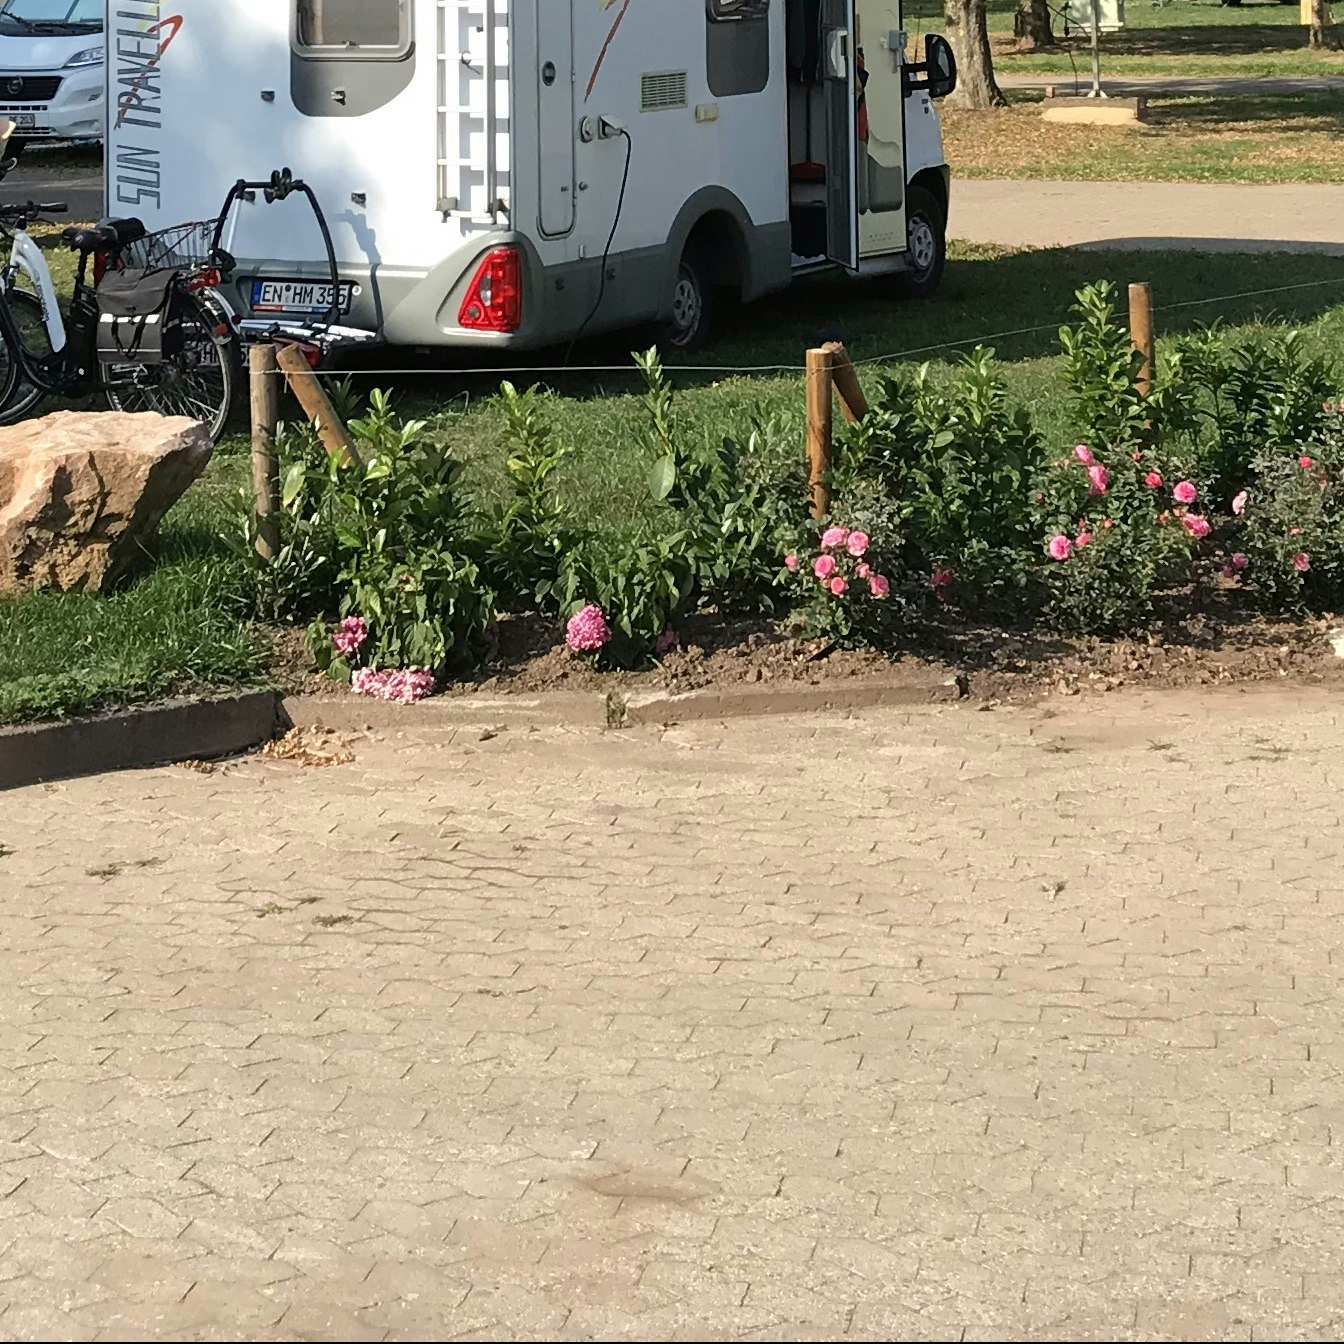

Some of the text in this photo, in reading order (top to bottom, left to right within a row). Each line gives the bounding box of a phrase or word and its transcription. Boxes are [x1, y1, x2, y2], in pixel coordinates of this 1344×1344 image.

[116, 144, 161, 210] SUN
[261, 284, 284, 303] EN
[291, 286, 314, 305] HM
